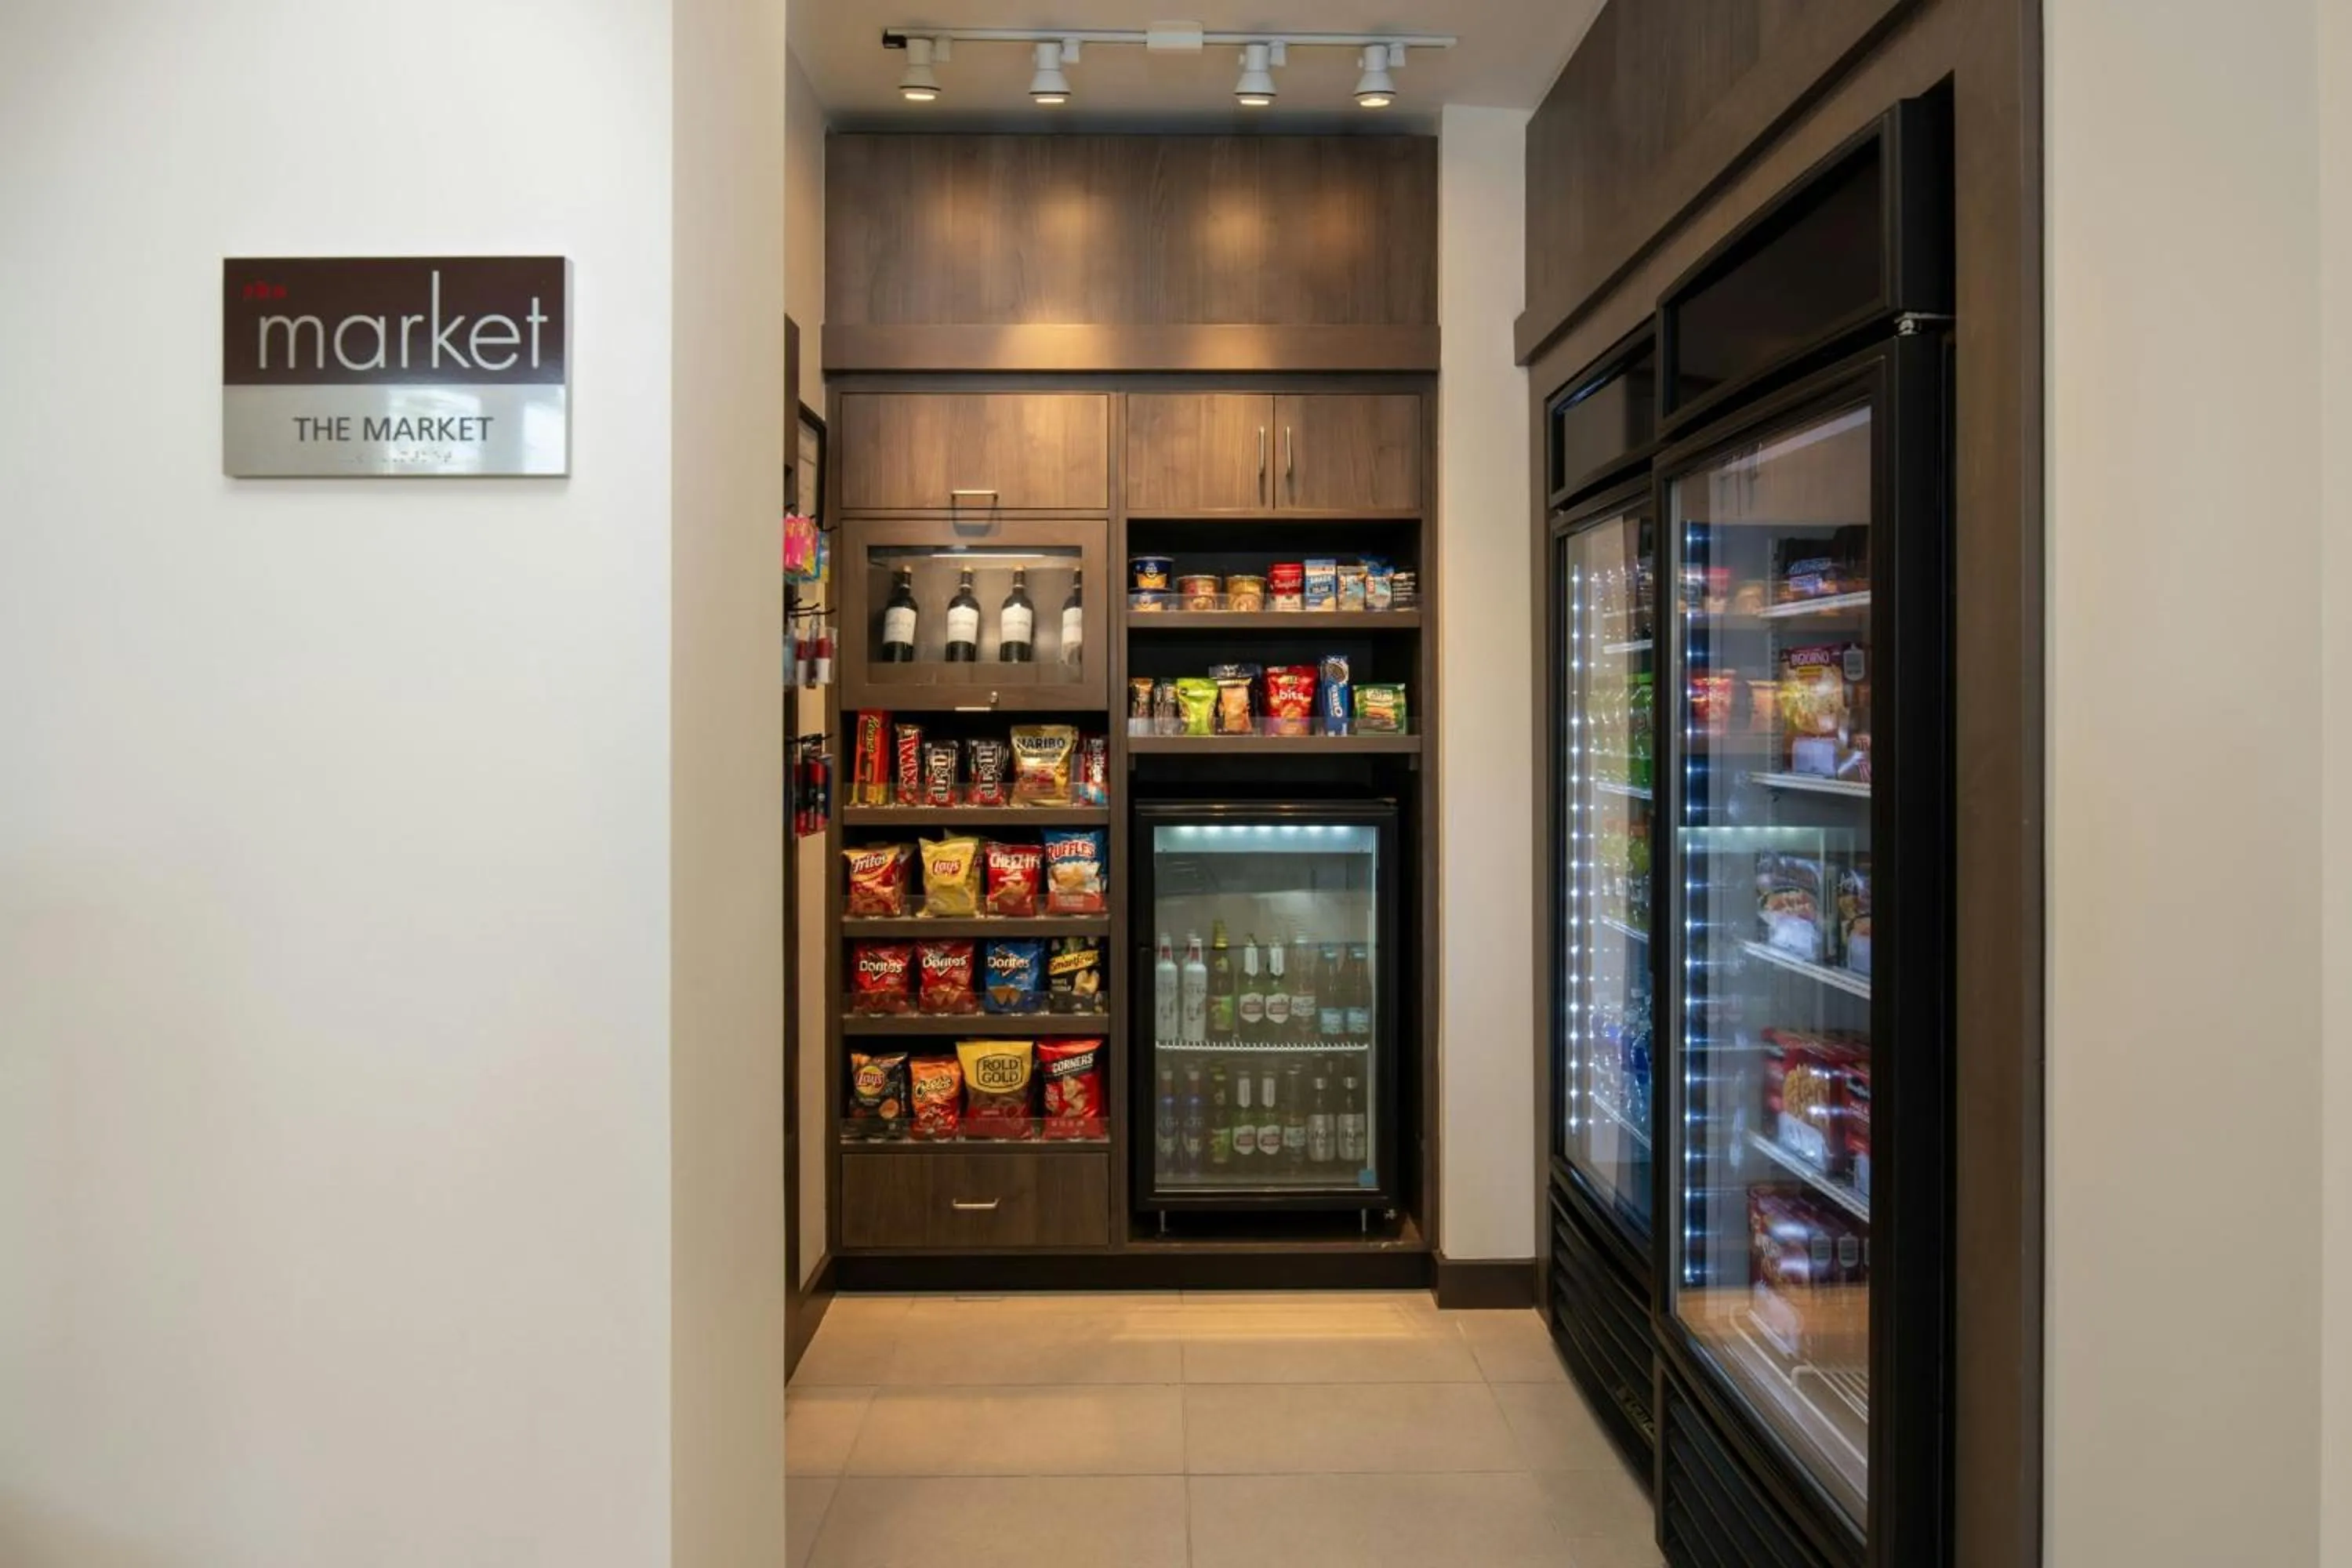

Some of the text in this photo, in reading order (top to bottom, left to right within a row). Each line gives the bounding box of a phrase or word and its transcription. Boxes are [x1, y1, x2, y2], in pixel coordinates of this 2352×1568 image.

[259, 270, 548, 371] market
[293, 417, 493, 441] THE MARKET
[859, 960, 902, 973] Doritos
[923, 956, 967, 968] Doritos
[987, 956, 1029, 968] Doritos
[982, 1059, 1018, 1071] ROLD
[982, 1072, 1018, 1083] GOLD
